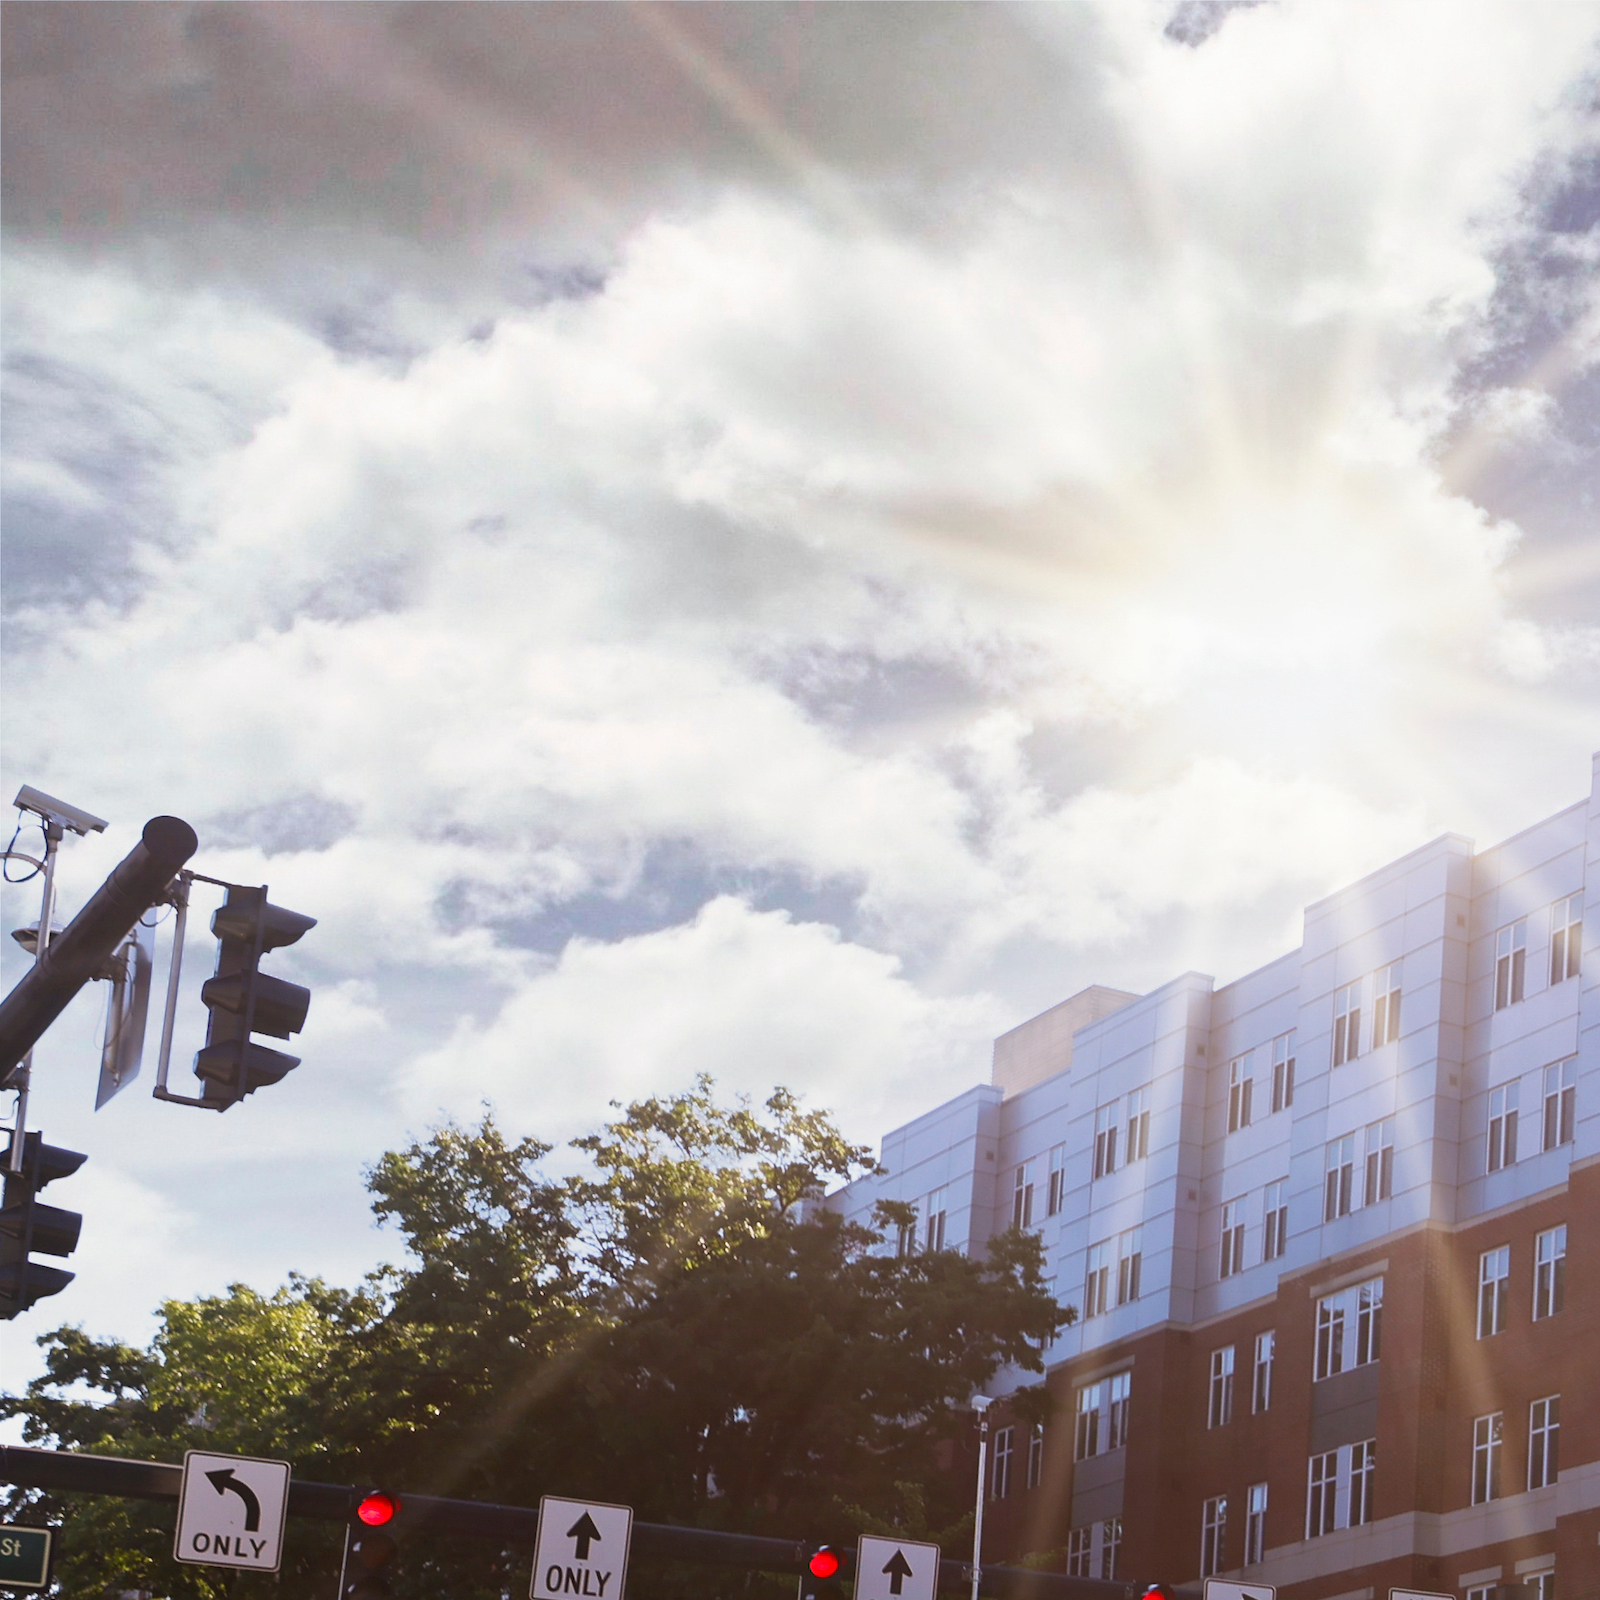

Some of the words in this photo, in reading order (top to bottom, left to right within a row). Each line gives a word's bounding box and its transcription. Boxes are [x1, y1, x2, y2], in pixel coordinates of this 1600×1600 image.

[0, 1538, 21, 1557] St
[193, 1532, 267, 1559] ONLY
[546, 1564, 612, 1598] ONLY
